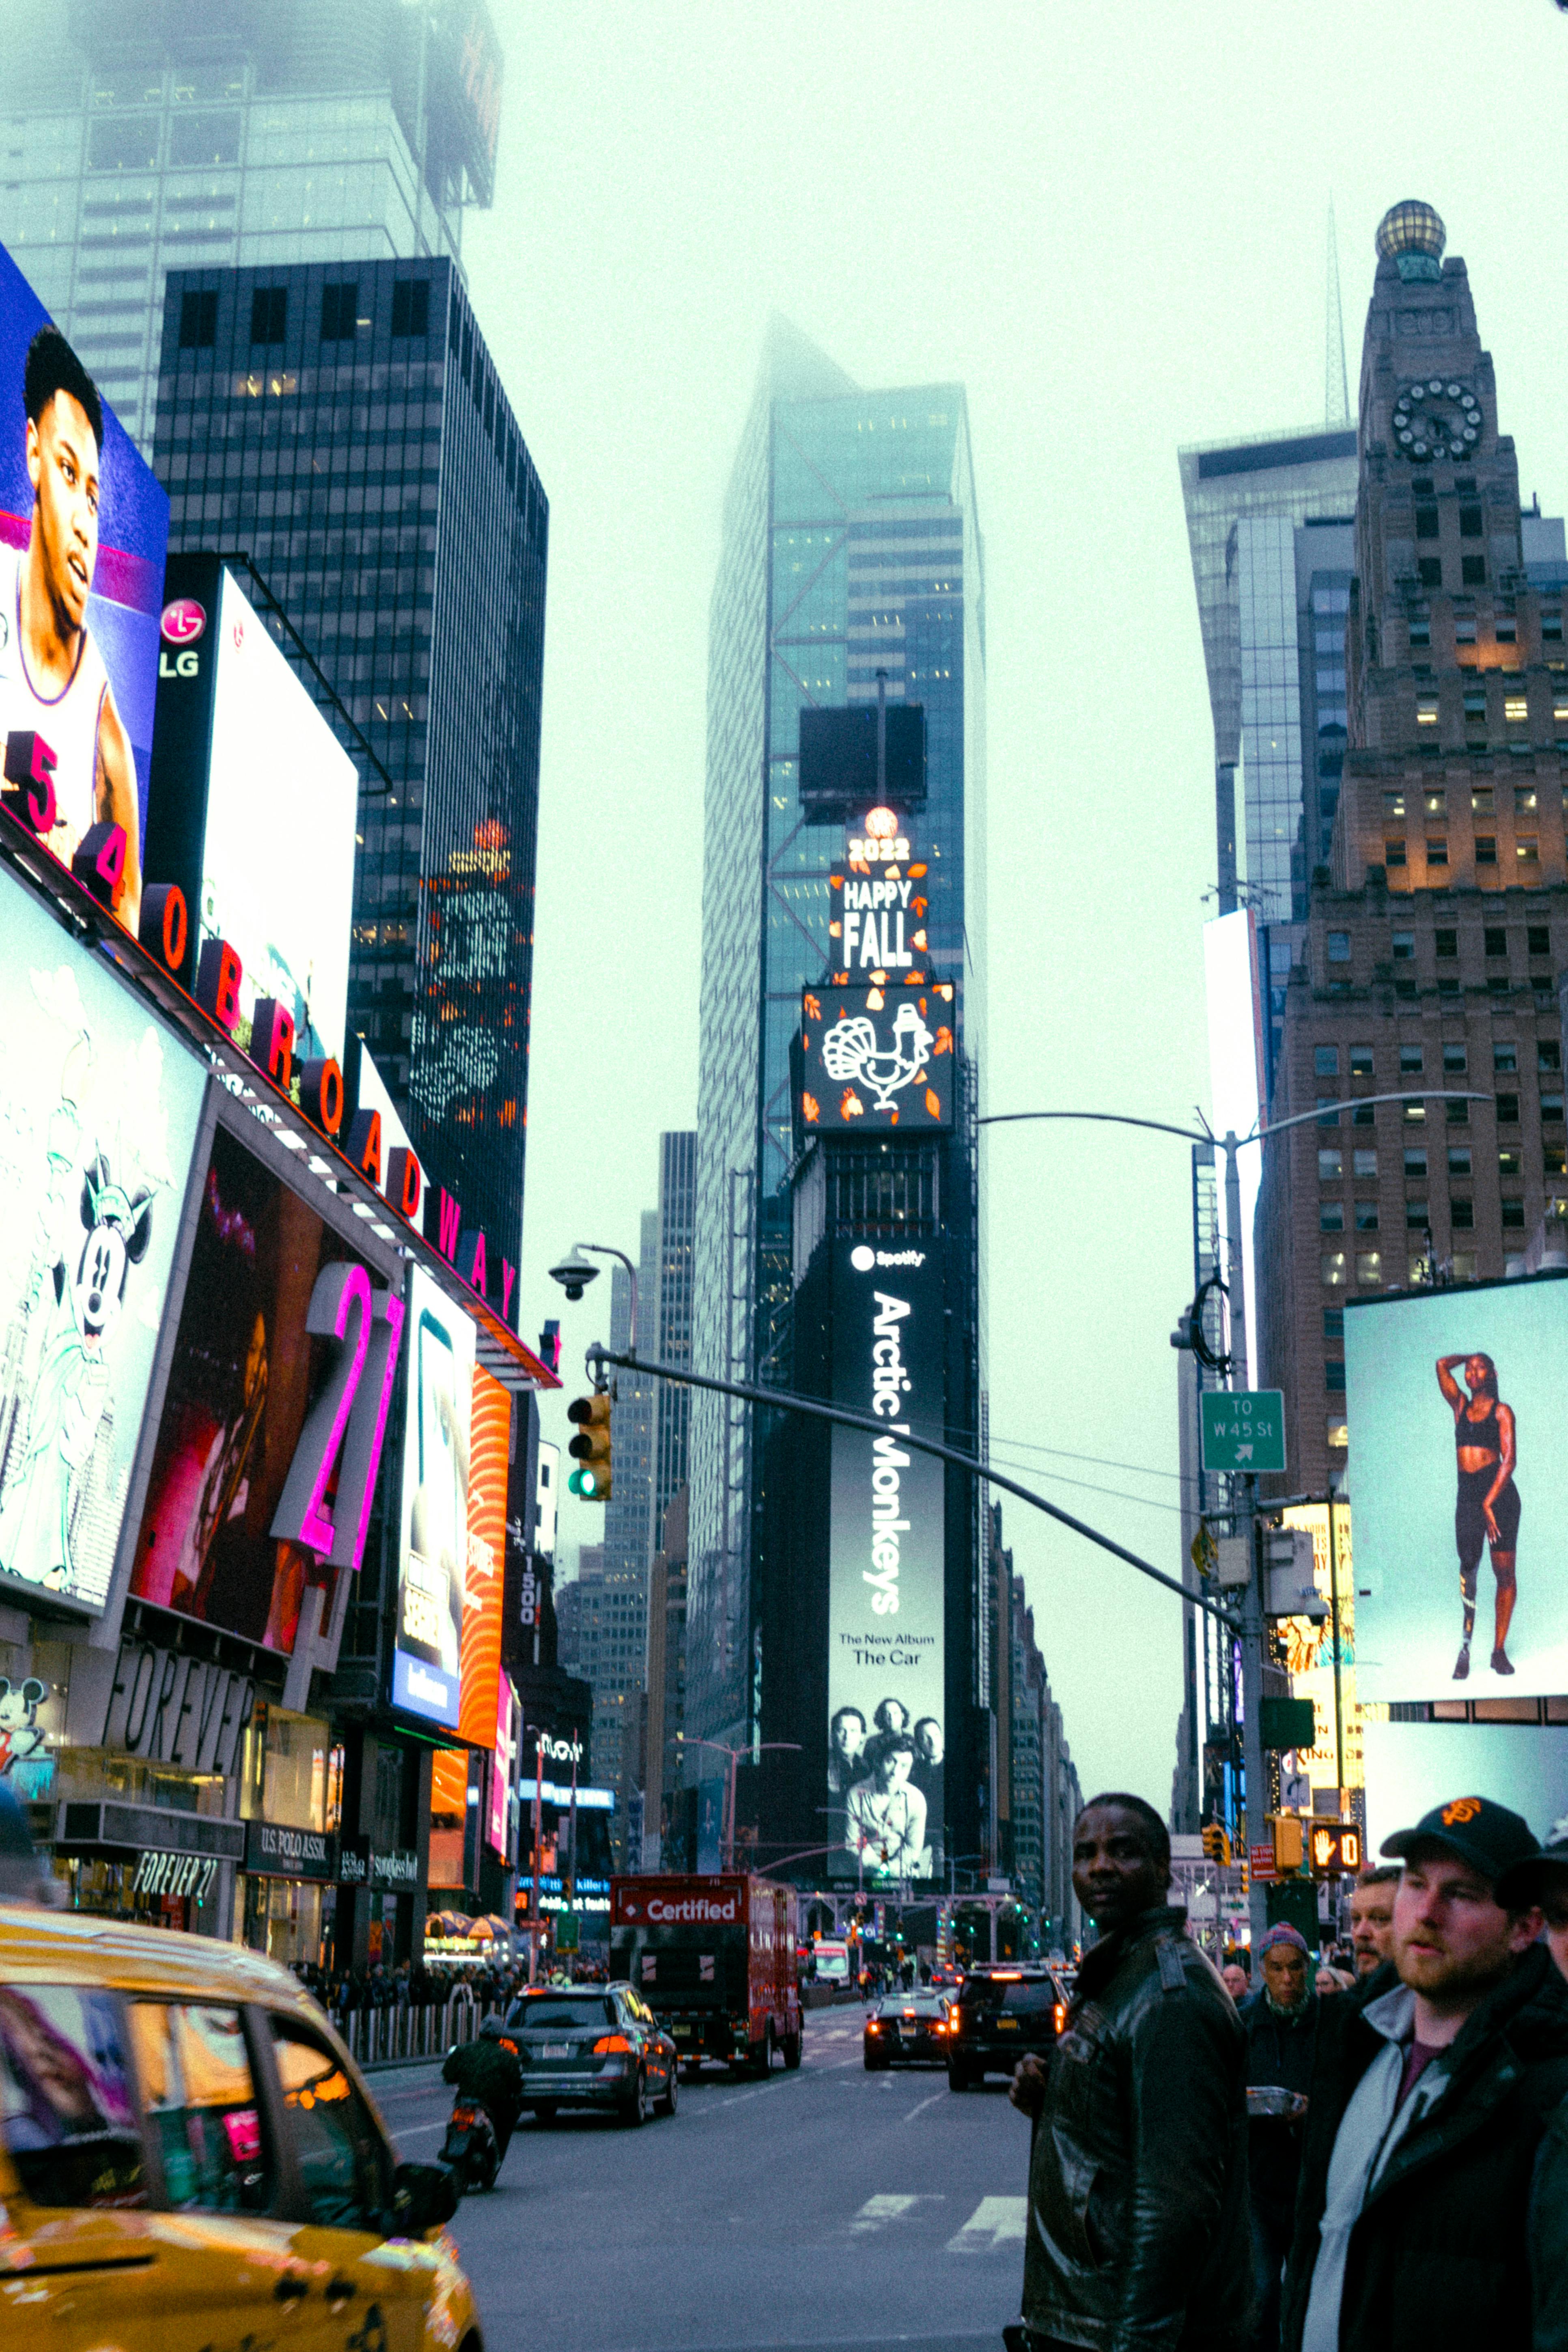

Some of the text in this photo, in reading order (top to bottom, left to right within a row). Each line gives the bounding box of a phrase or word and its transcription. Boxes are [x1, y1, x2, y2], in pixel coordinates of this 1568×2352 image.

[159, 650, 199, 678] LG
[849, 838, 910, 861] 2022
[844, 880, 912, 910] HAPPY
[844, 911, 913, 968] FALL
[205, 939, 515, 1320] BROADWAY
[877, 1250, 924, 1267] Spotify
[299, 1264, 405, 1571] 21
[1232, 1400, 1253, 1415] TO
[1214, 1422, 1273, 1437] W 45 St
[863, 1290, 911, 1615] Arctic Monkeys
[520, 1555, 535, 1625] 1500
[839, 1633, 935, 1644] The New Album
[853, 1649, 921, 1665] The Car
[101, 1633, 256, 1777] FOREVER
[262, 1827, 277, 1854] U.S.
[278, 1830, 302, 1858] POLO
[1340, 1833, 1358, 1866] 10
[133, 1851, 218, 1898] FOREVER 21
[647, 1899, 735, 1921] Certified
